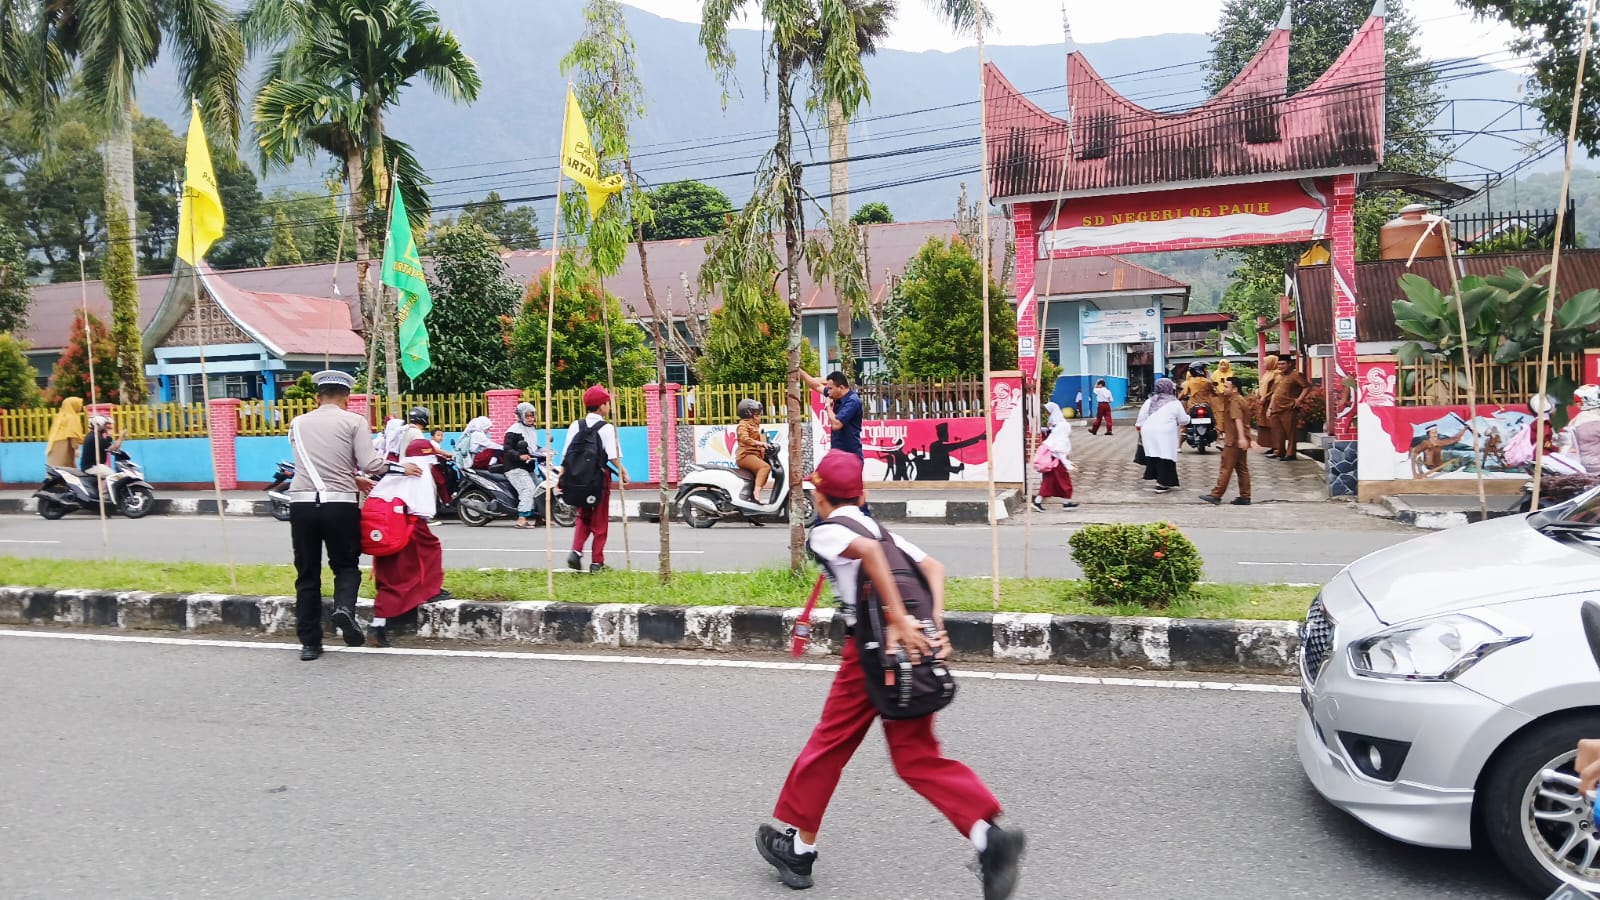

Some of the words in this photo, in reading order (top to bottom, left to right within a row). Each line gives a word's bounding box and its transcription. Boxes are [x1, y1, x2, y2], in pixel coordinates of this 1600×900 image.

[1082, 215, 1105, 227] SD
[1111, 208, 1183, 224] NEGERI
[1189, 207, 1211, 217] 05
[1219, 202, 1270, 216] PAUH
